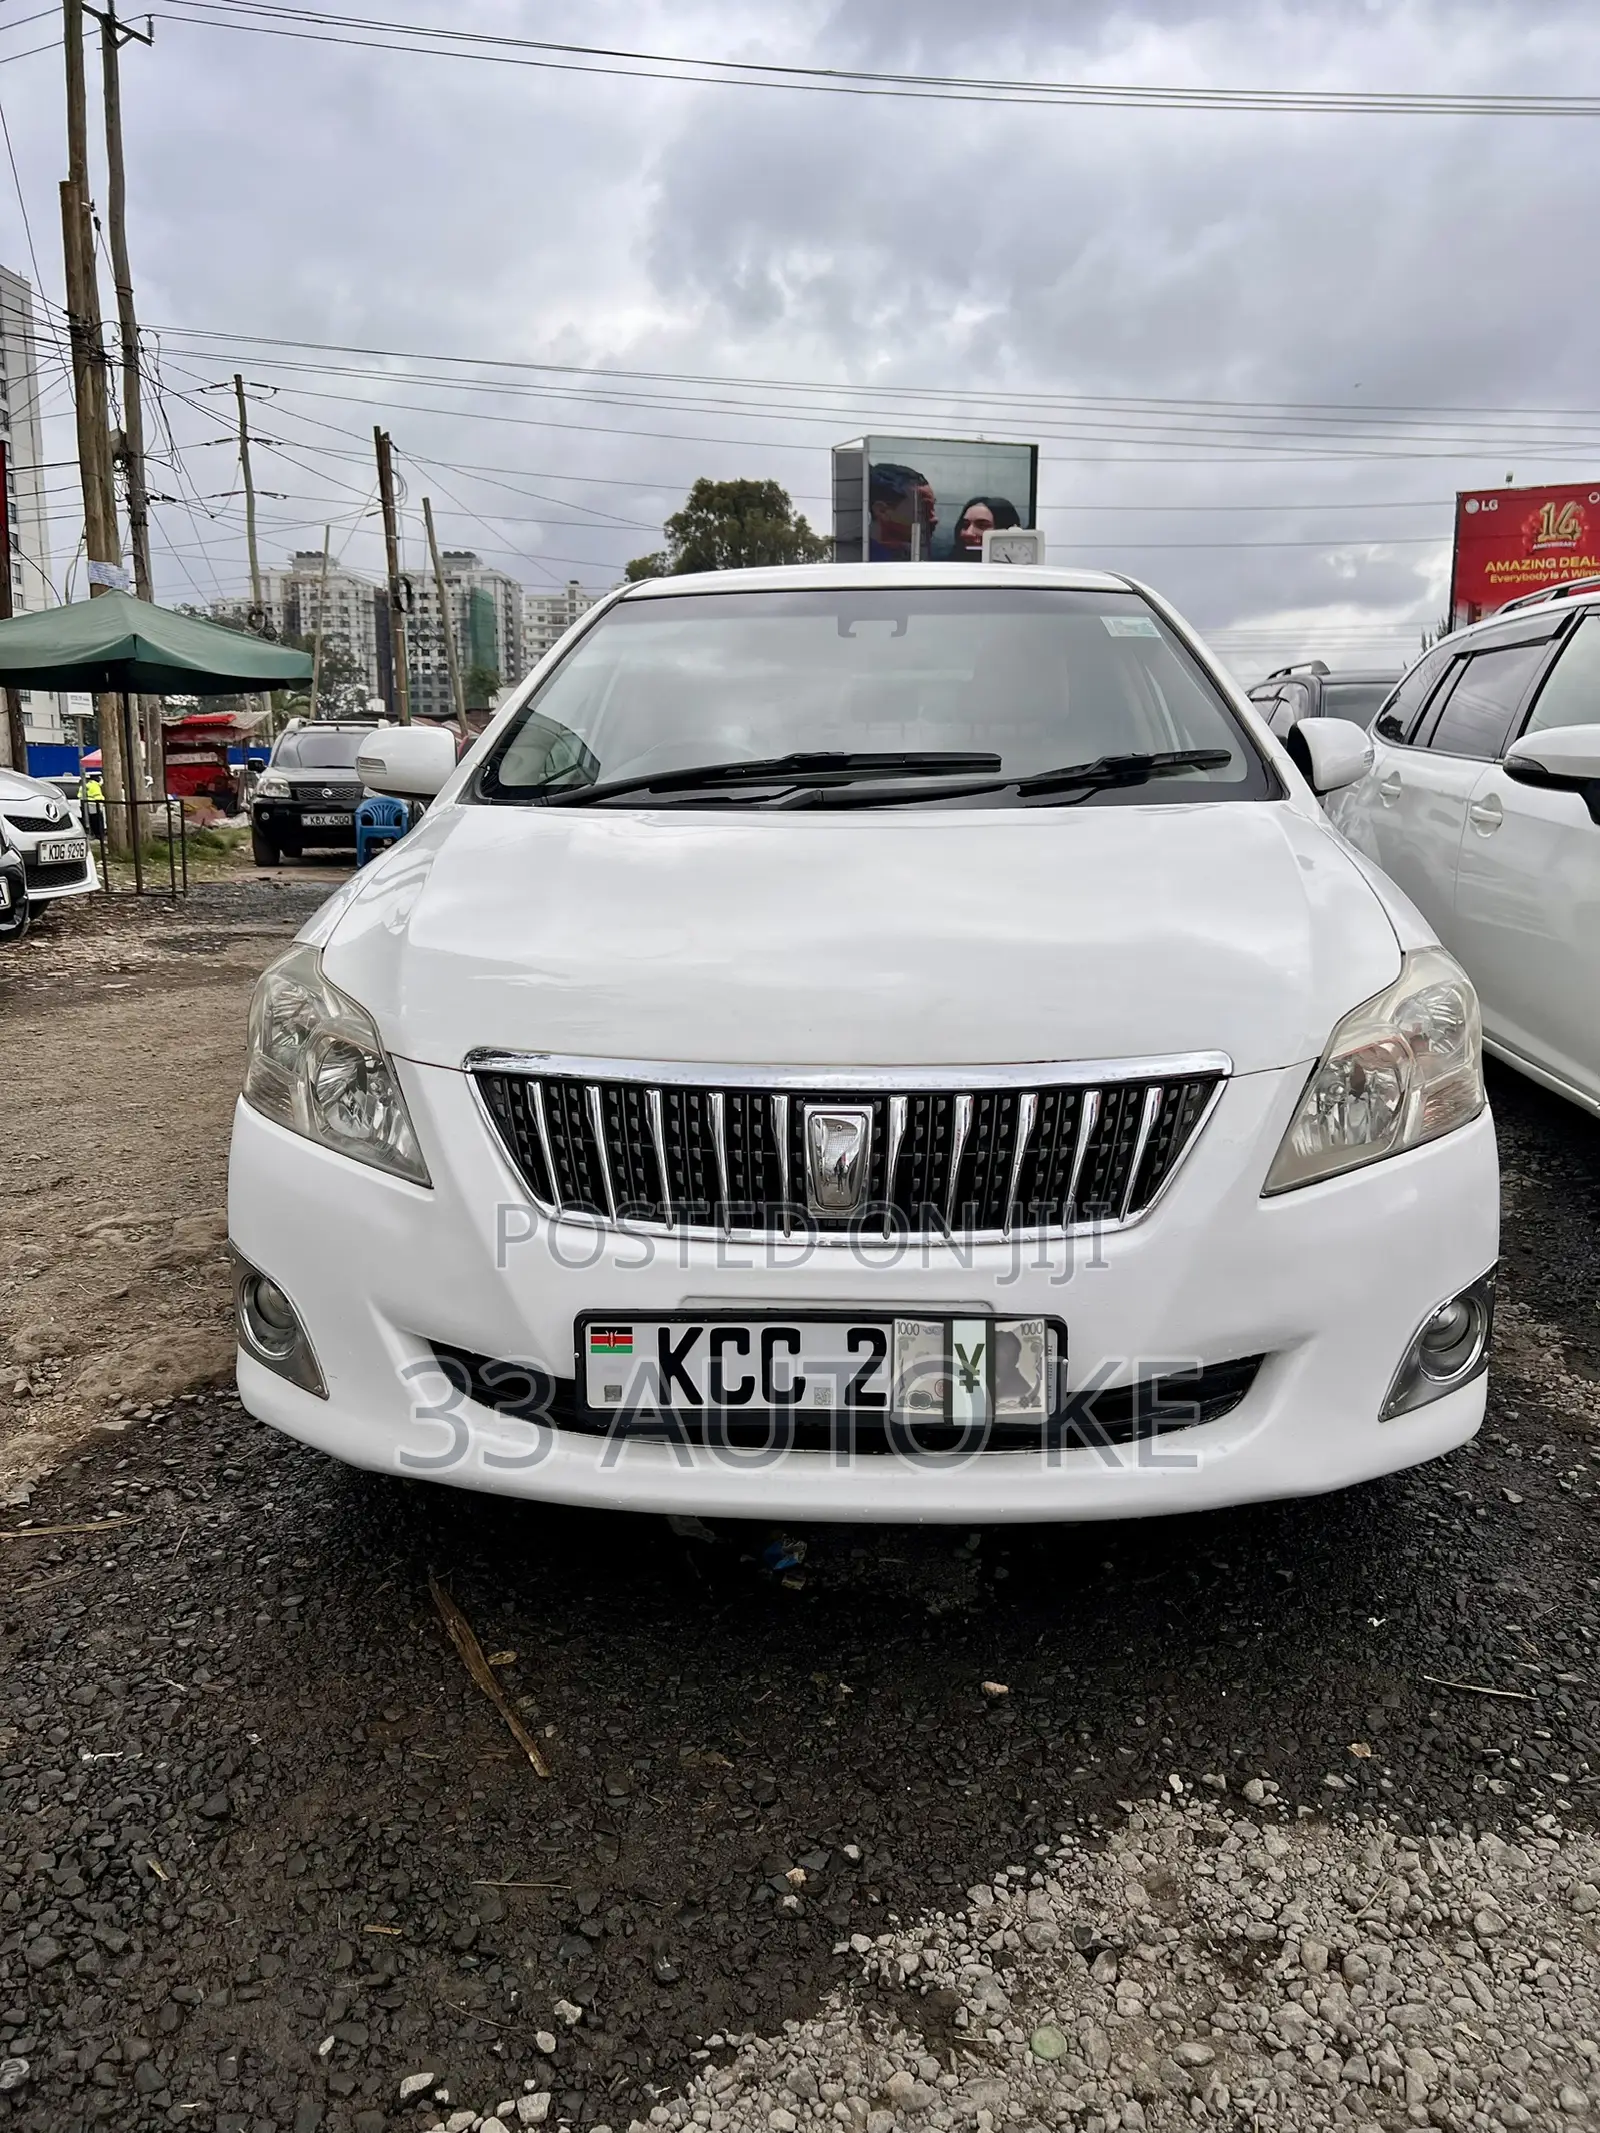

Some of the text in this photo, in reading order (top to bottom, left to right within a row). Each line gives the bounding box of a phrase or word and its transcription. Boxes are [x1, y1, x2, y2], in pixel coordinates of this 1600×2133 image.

[1482, 499, 1498, 512] LG
[1484, 557, 1556, 573] AMAZING
[1490, 570, 1549, 584] Everybody
[1561, 570, 1569, 579] A
[310, 815, 328, 825] KBX
[48, 842, 85, 860] KDG 929G
[657, 1326, 805, 1406] KCC
